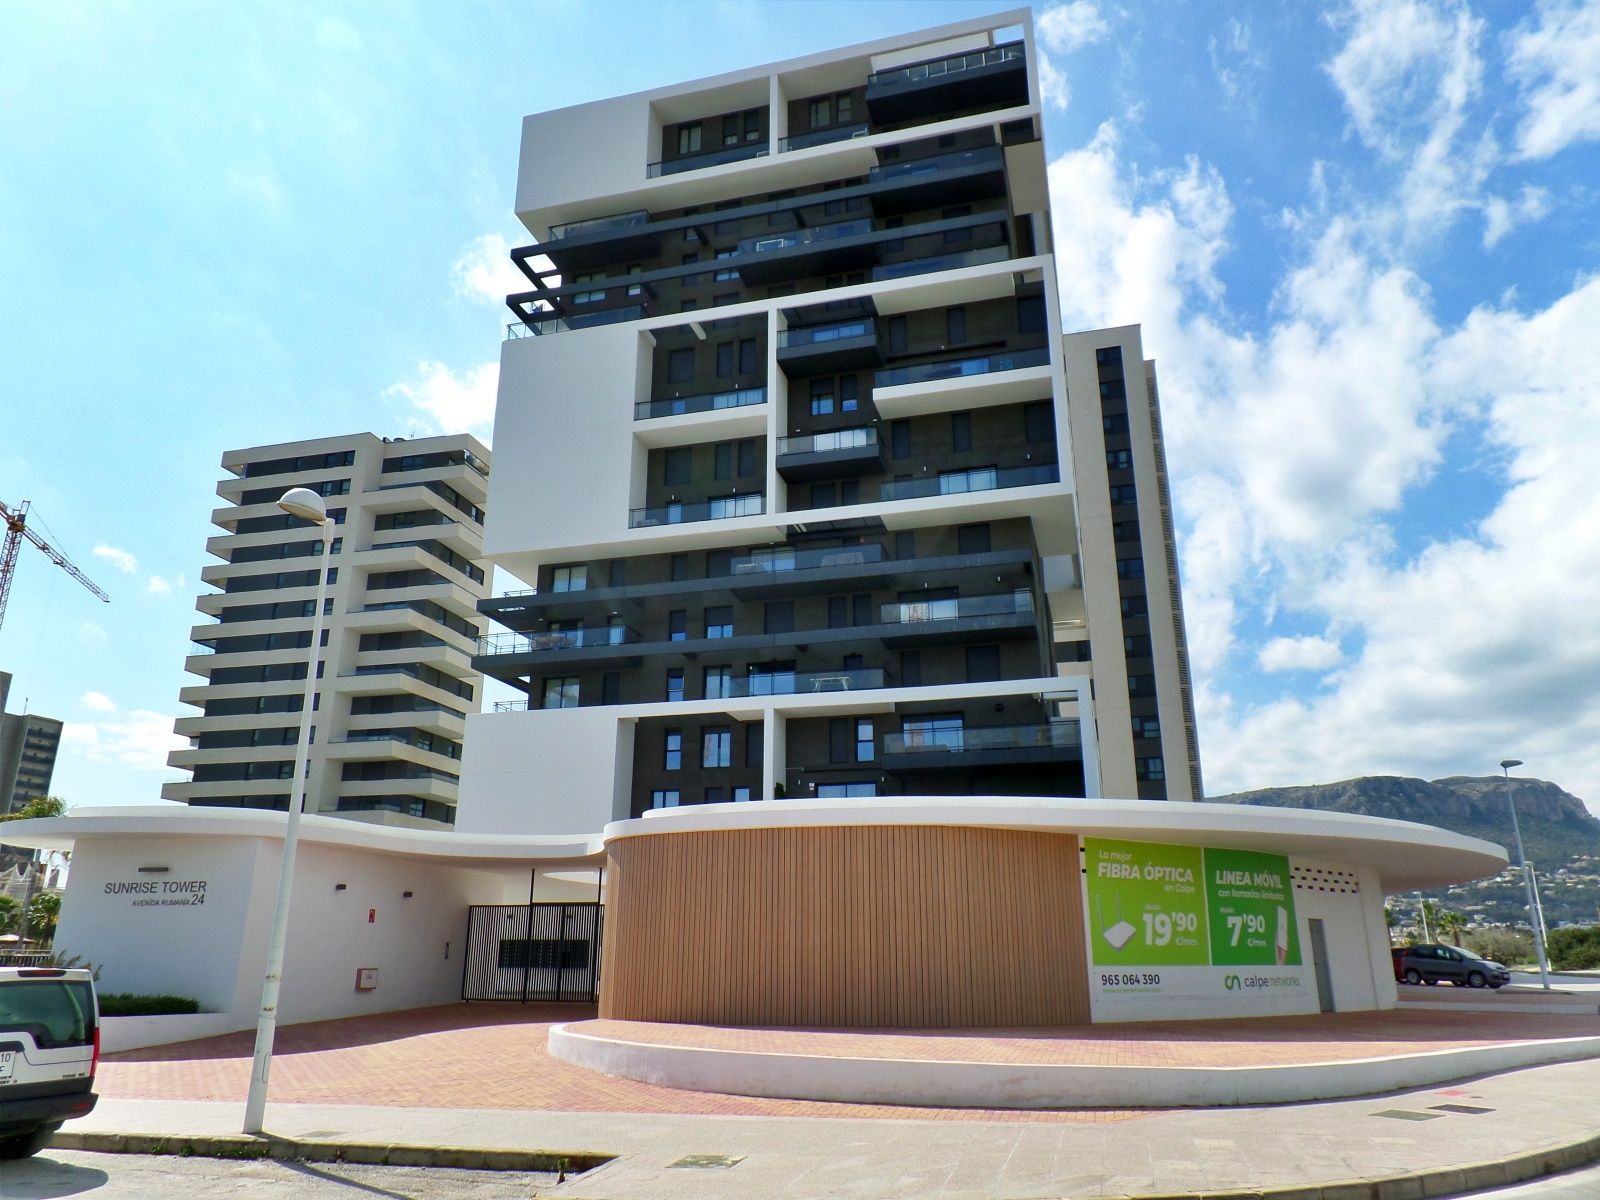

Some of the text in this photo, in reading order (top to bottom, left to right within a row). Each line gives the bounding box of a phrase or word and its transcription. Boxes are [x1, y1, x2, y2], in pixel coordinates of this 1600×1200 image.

[1110, 850, 1132, 862] mejor
[1097, 861, 1195, 882] FIBRA ÓPTICA
[1215, 870, 1284, 888] LINEA MÓVIL
[104, 881, 208, 894] SUNRISE TOWER
[1218, 889, 1231, 897] con
[190, 893, 205, 905] 24
[1101, 974, 1160, 986] 965 064 390
